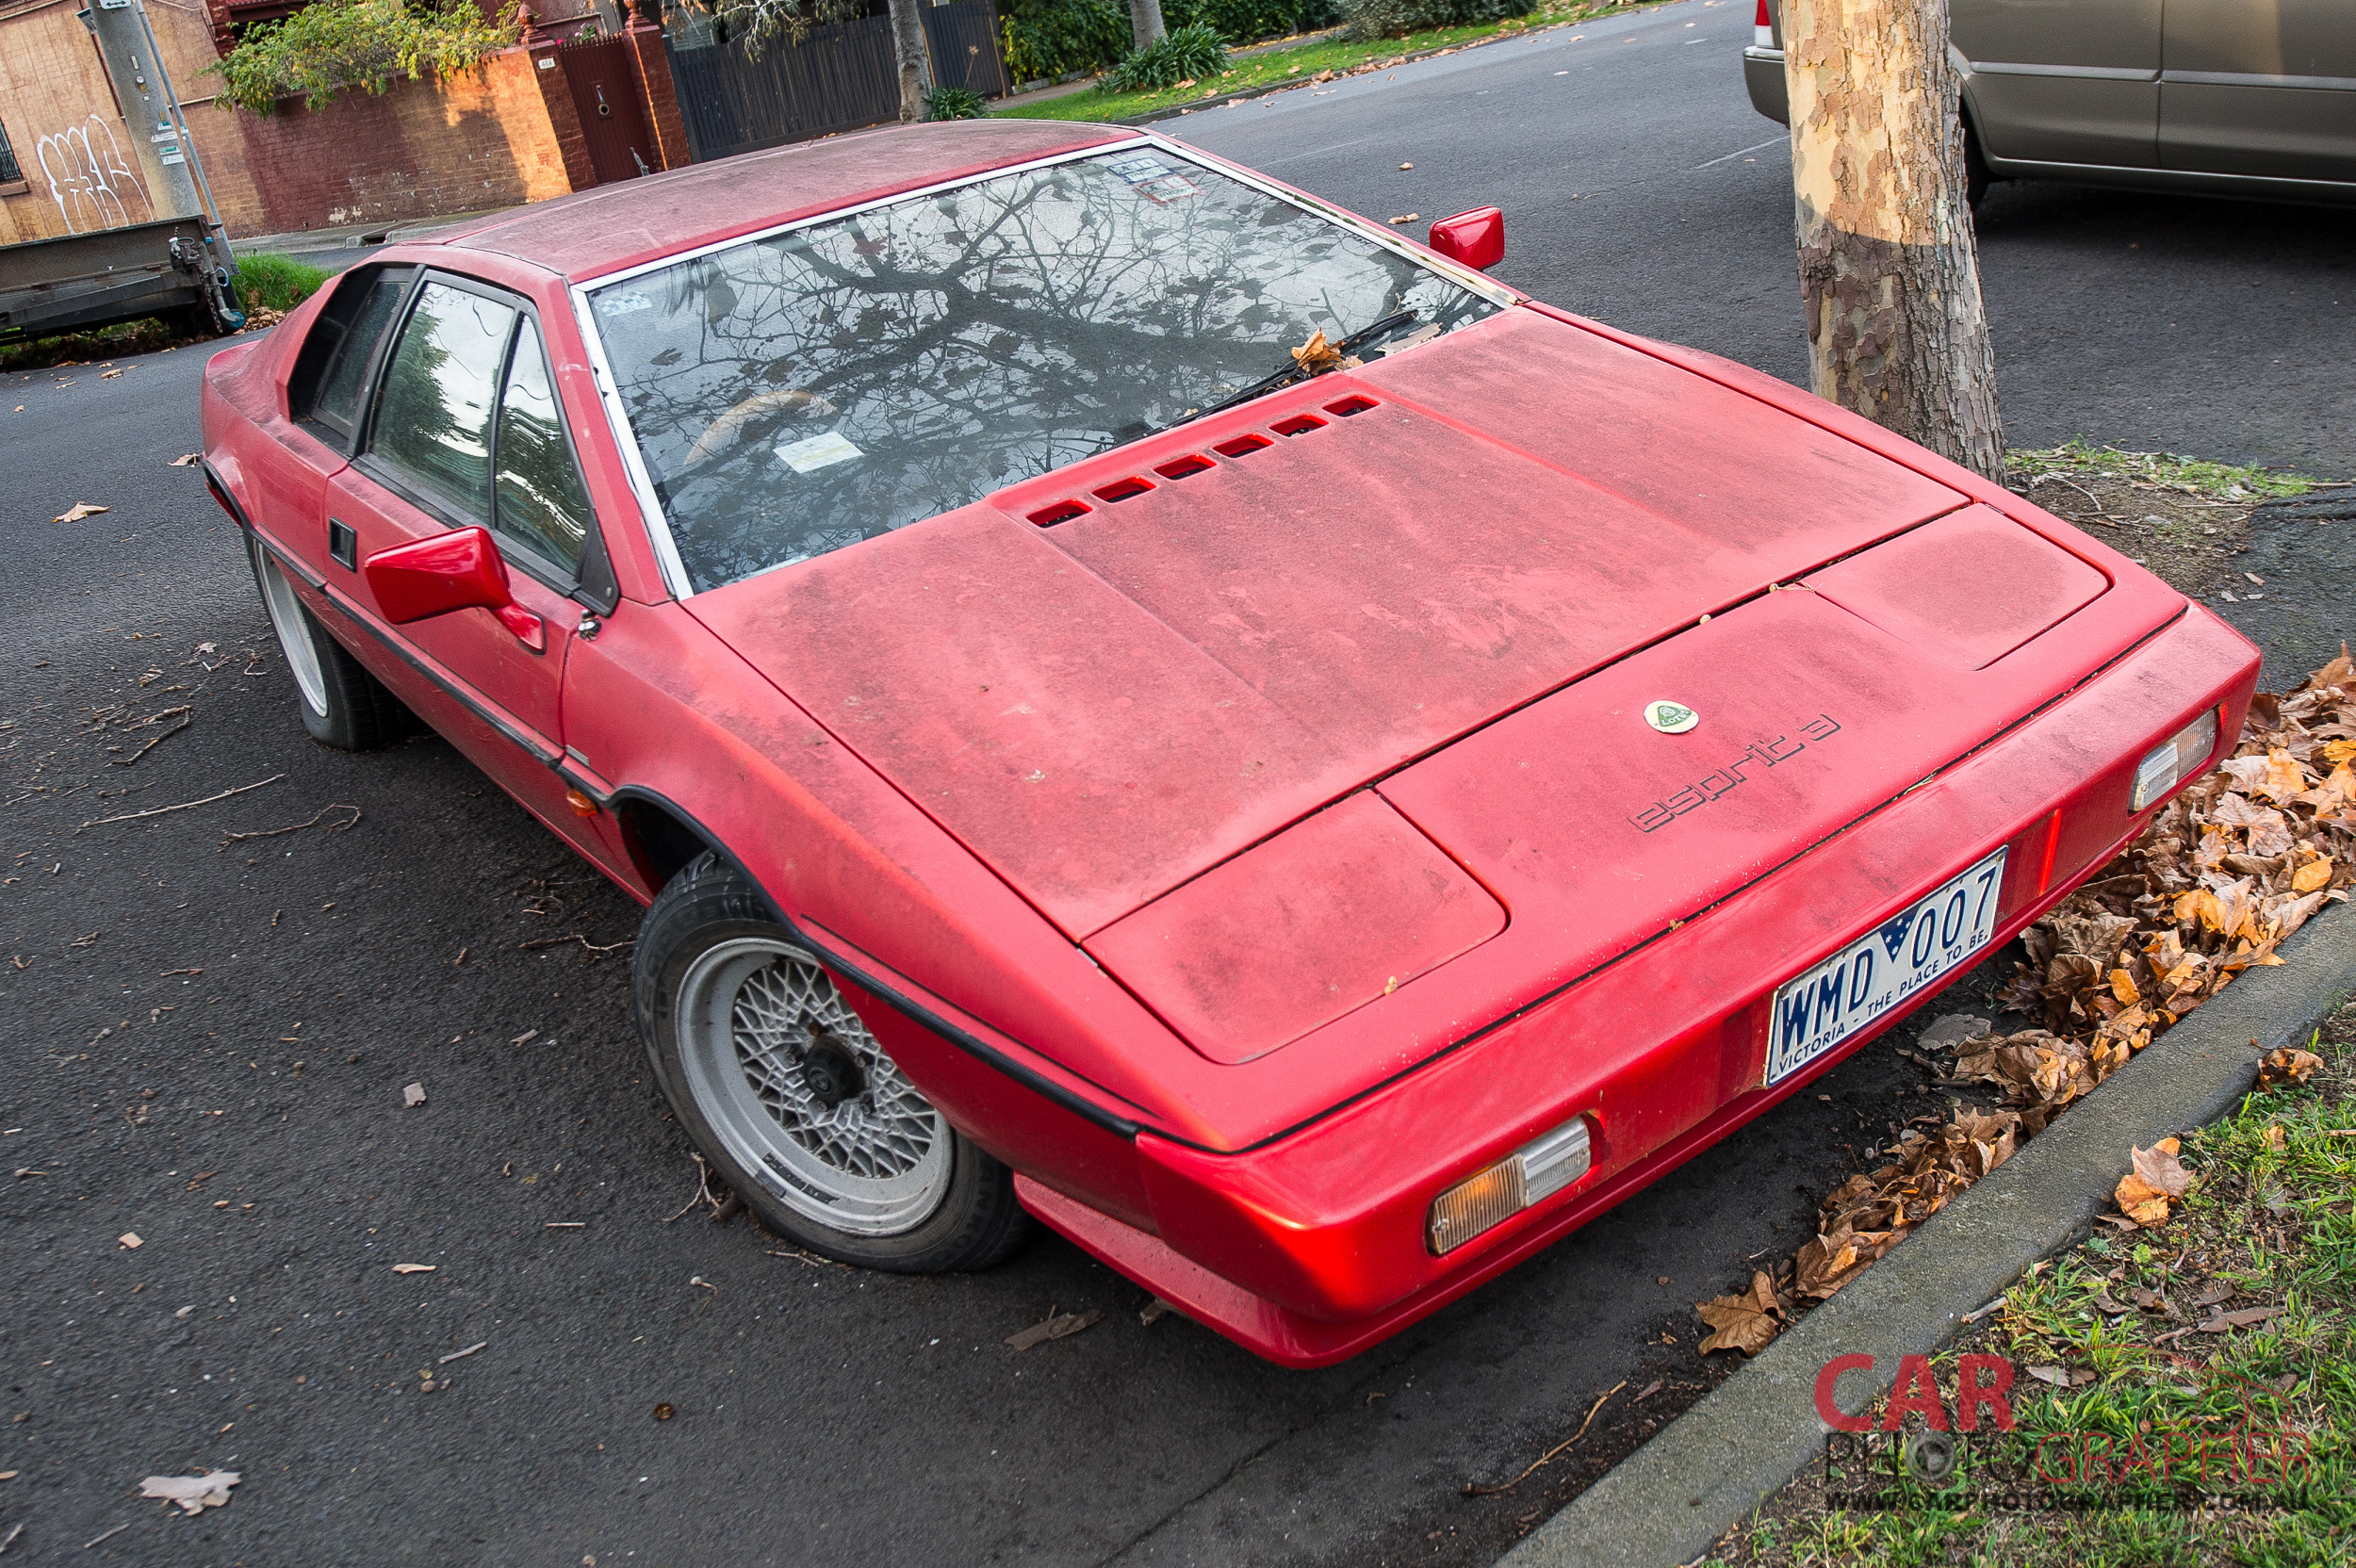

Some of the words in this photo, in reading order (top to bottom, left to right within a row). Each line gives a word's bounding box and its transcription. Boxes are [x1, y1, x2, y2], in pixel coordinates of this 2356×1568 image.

[1661, 709, 1691, 726] LOTUS
[1627, 735, 1806, 833] esprit
[1778, 1021, 1845, 1073] VICTORIA
[1867, 990, 1892, 1017] THE
[1899, 959, 1939, 996] PLACE
[1946, 944, 1962, 964] TO
[1780, 946, 1873, 1057] WMD
[1911, 864, 1997, 970] 007
